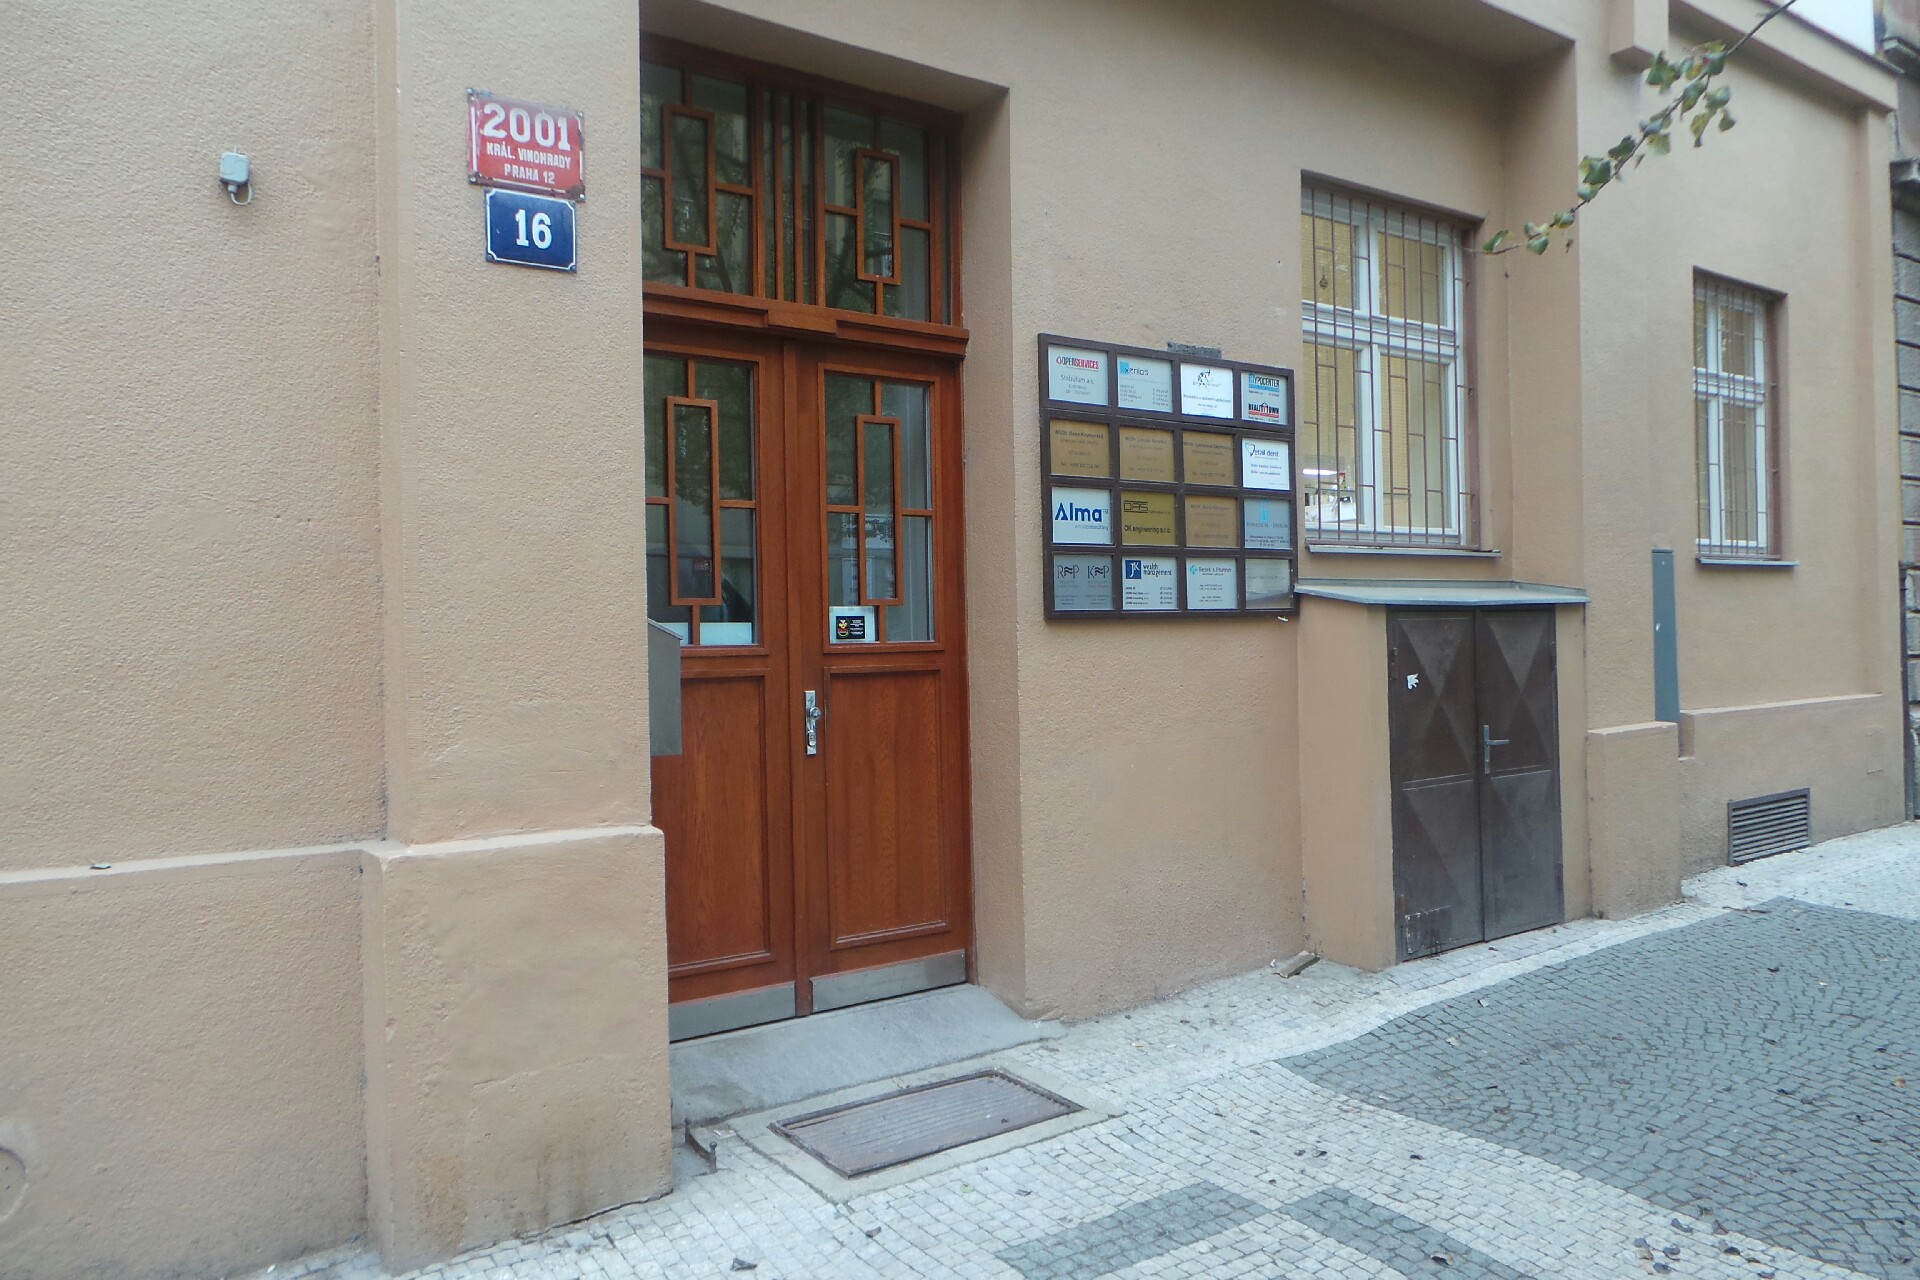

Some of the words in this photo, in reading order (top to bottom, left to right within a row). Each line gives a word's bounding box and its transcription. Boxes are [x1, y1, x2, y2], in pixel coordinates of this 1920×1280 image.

[480, 102, 571, 151] 2001
[518, 148, 572, 169] VINOHRADY
[504, 163, 540, 182] PRAHA
[543, 171, 555, 185] 12
[515, 208, 553, 250] 16
[1054, 502, 1103, 522] Alma
[1132, 526, 1160, 535] engineering
[1143, 562, 1159, 571] wealth
[1143, 569, 1173, 578] management
